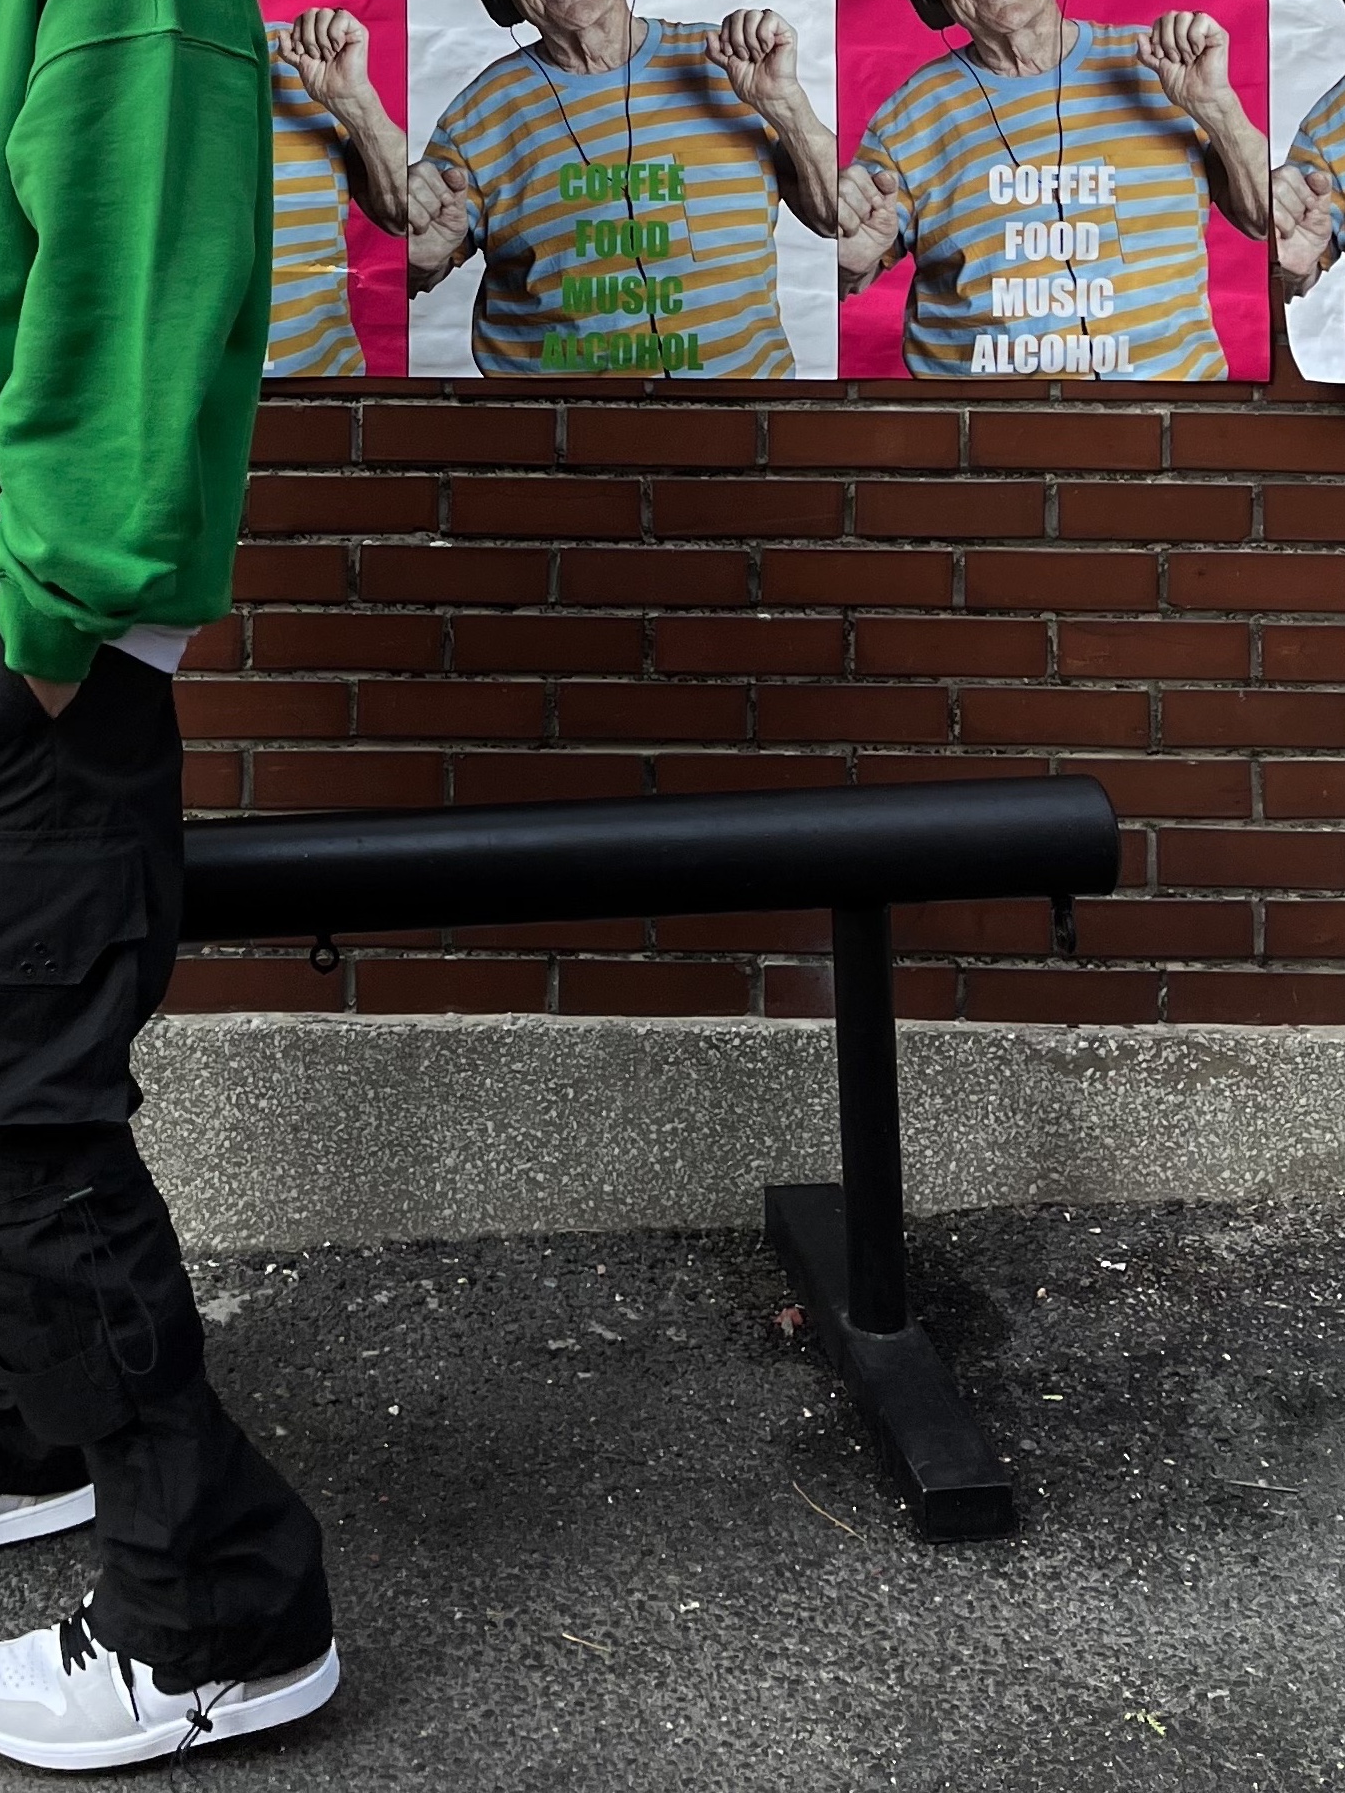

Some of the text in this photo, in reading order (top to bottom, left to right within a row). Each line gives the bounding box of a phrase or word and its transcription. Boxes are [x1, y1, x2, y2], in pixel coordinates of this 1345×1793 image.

[559, 163, 684, 203] COFFEE
[989, 165, 1116, 204] COFFEE
[575, 220, 669, 259] FOOD
[1005, 221, 1099, 261] FOOD
[562, 276, 683, 315] MUSIC
[992, 278, 1114, 317] MUSIC
[542, 333, 703, 372] ALCOHOL
[971, 335, 1133, 373] ALCOHOL
